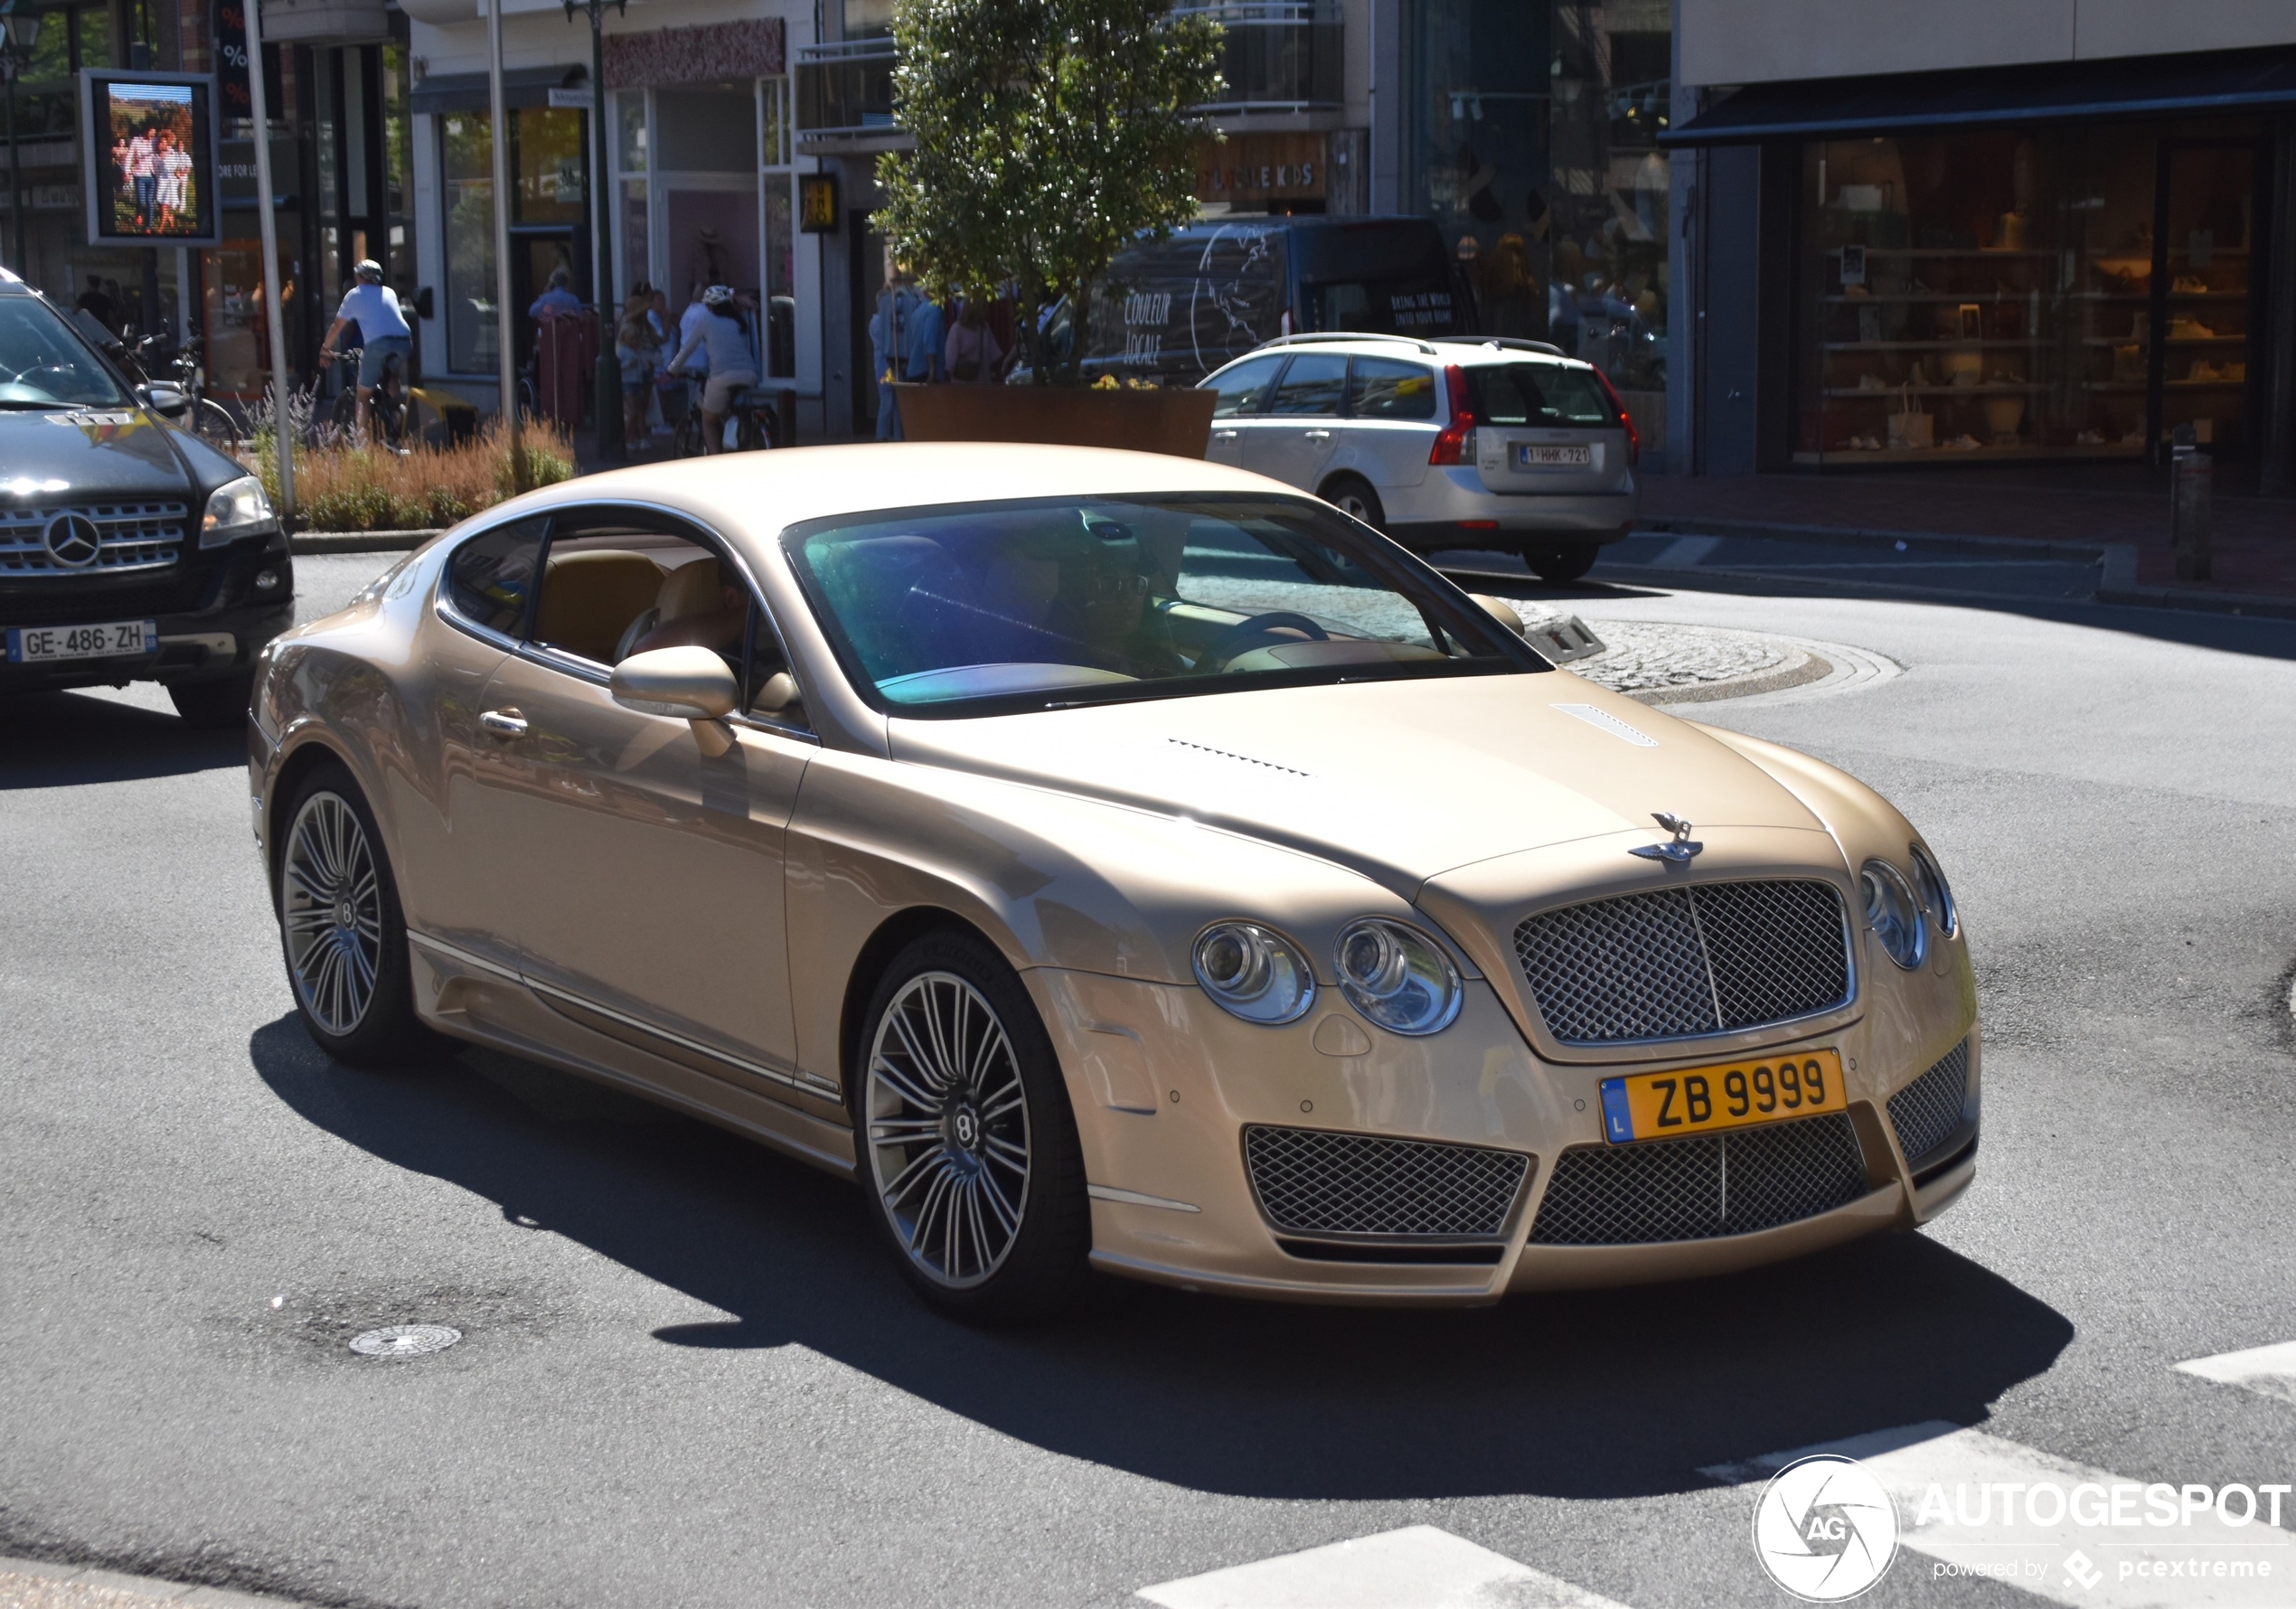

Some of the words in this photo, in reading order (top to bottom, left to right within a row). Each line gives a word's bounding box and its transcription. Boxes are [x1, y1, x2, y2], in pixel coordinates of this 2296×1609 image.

[233, 164, 248, 178] FOR
[1276, 163, 1313, 188] KIDS
[1124, 292, 1172, 325] COULEUR
[1390, 295, 1416, 311] BRING
[1416, 291, 1429, 307] THE
[1428, 291, 1452, 307] WORLD
[1395, 311, 1415, 327] INTO
[1416, 309, 1434, 324] YOUR
[1434, 308, 1453, 324] HOME
[1123, 329, 1162, 366] LOCALE
[26, 625, 142, 655] GE-486-ZH
[1651, 1075, 1712, 1127] ZB
[1724, 1059, 1826, 1117] 9999
[1613, 1116, 1624, 1134] L
